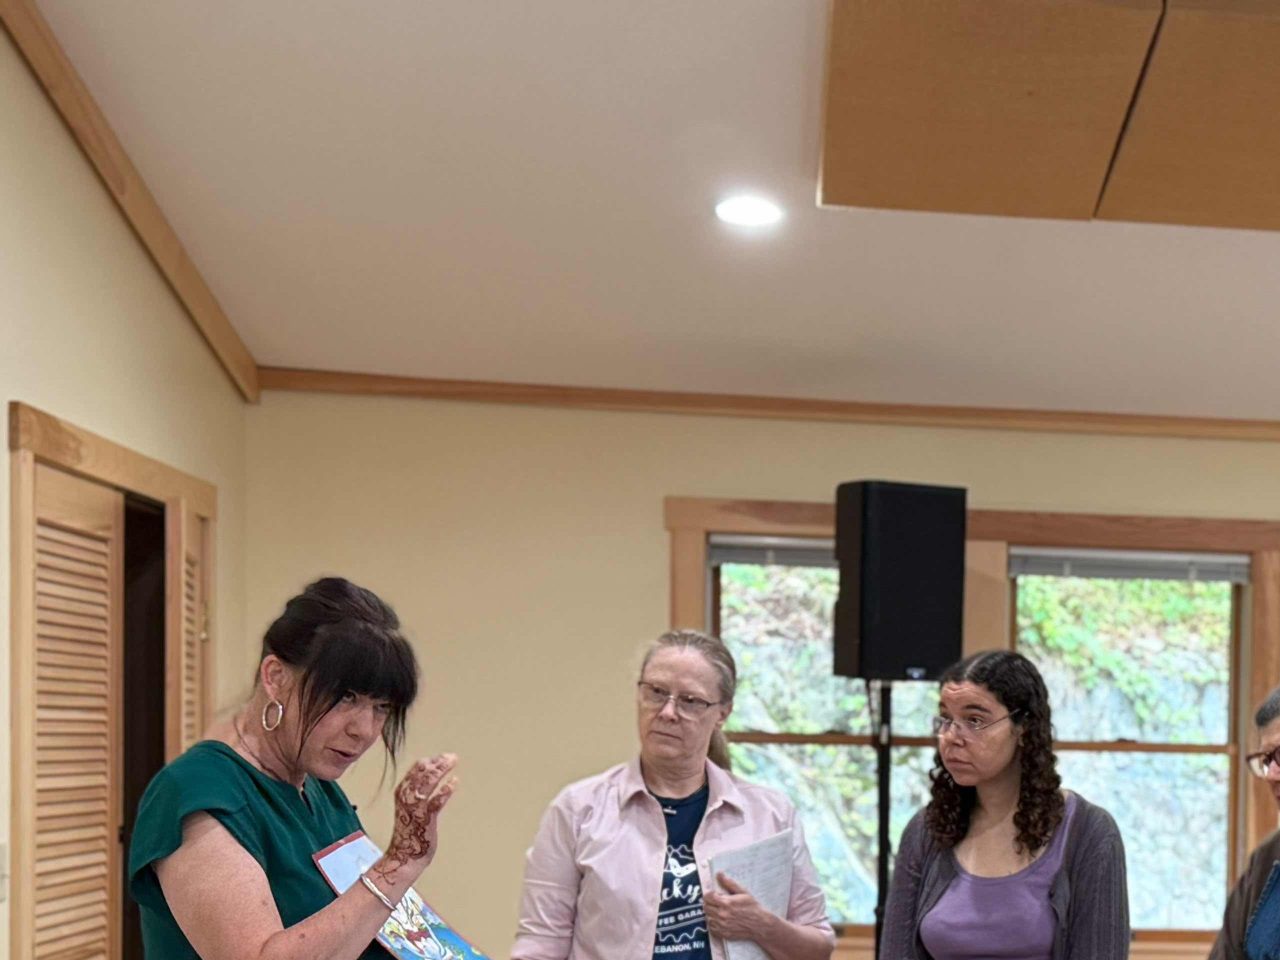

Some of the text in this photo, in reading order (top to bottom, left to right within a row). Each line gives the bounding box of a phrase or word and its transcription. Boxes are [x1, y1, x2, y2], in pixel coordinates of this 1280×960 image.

[658, 909, 703, 926] FEE GARA
[655, 941, 705, 953] EBANON, NH
